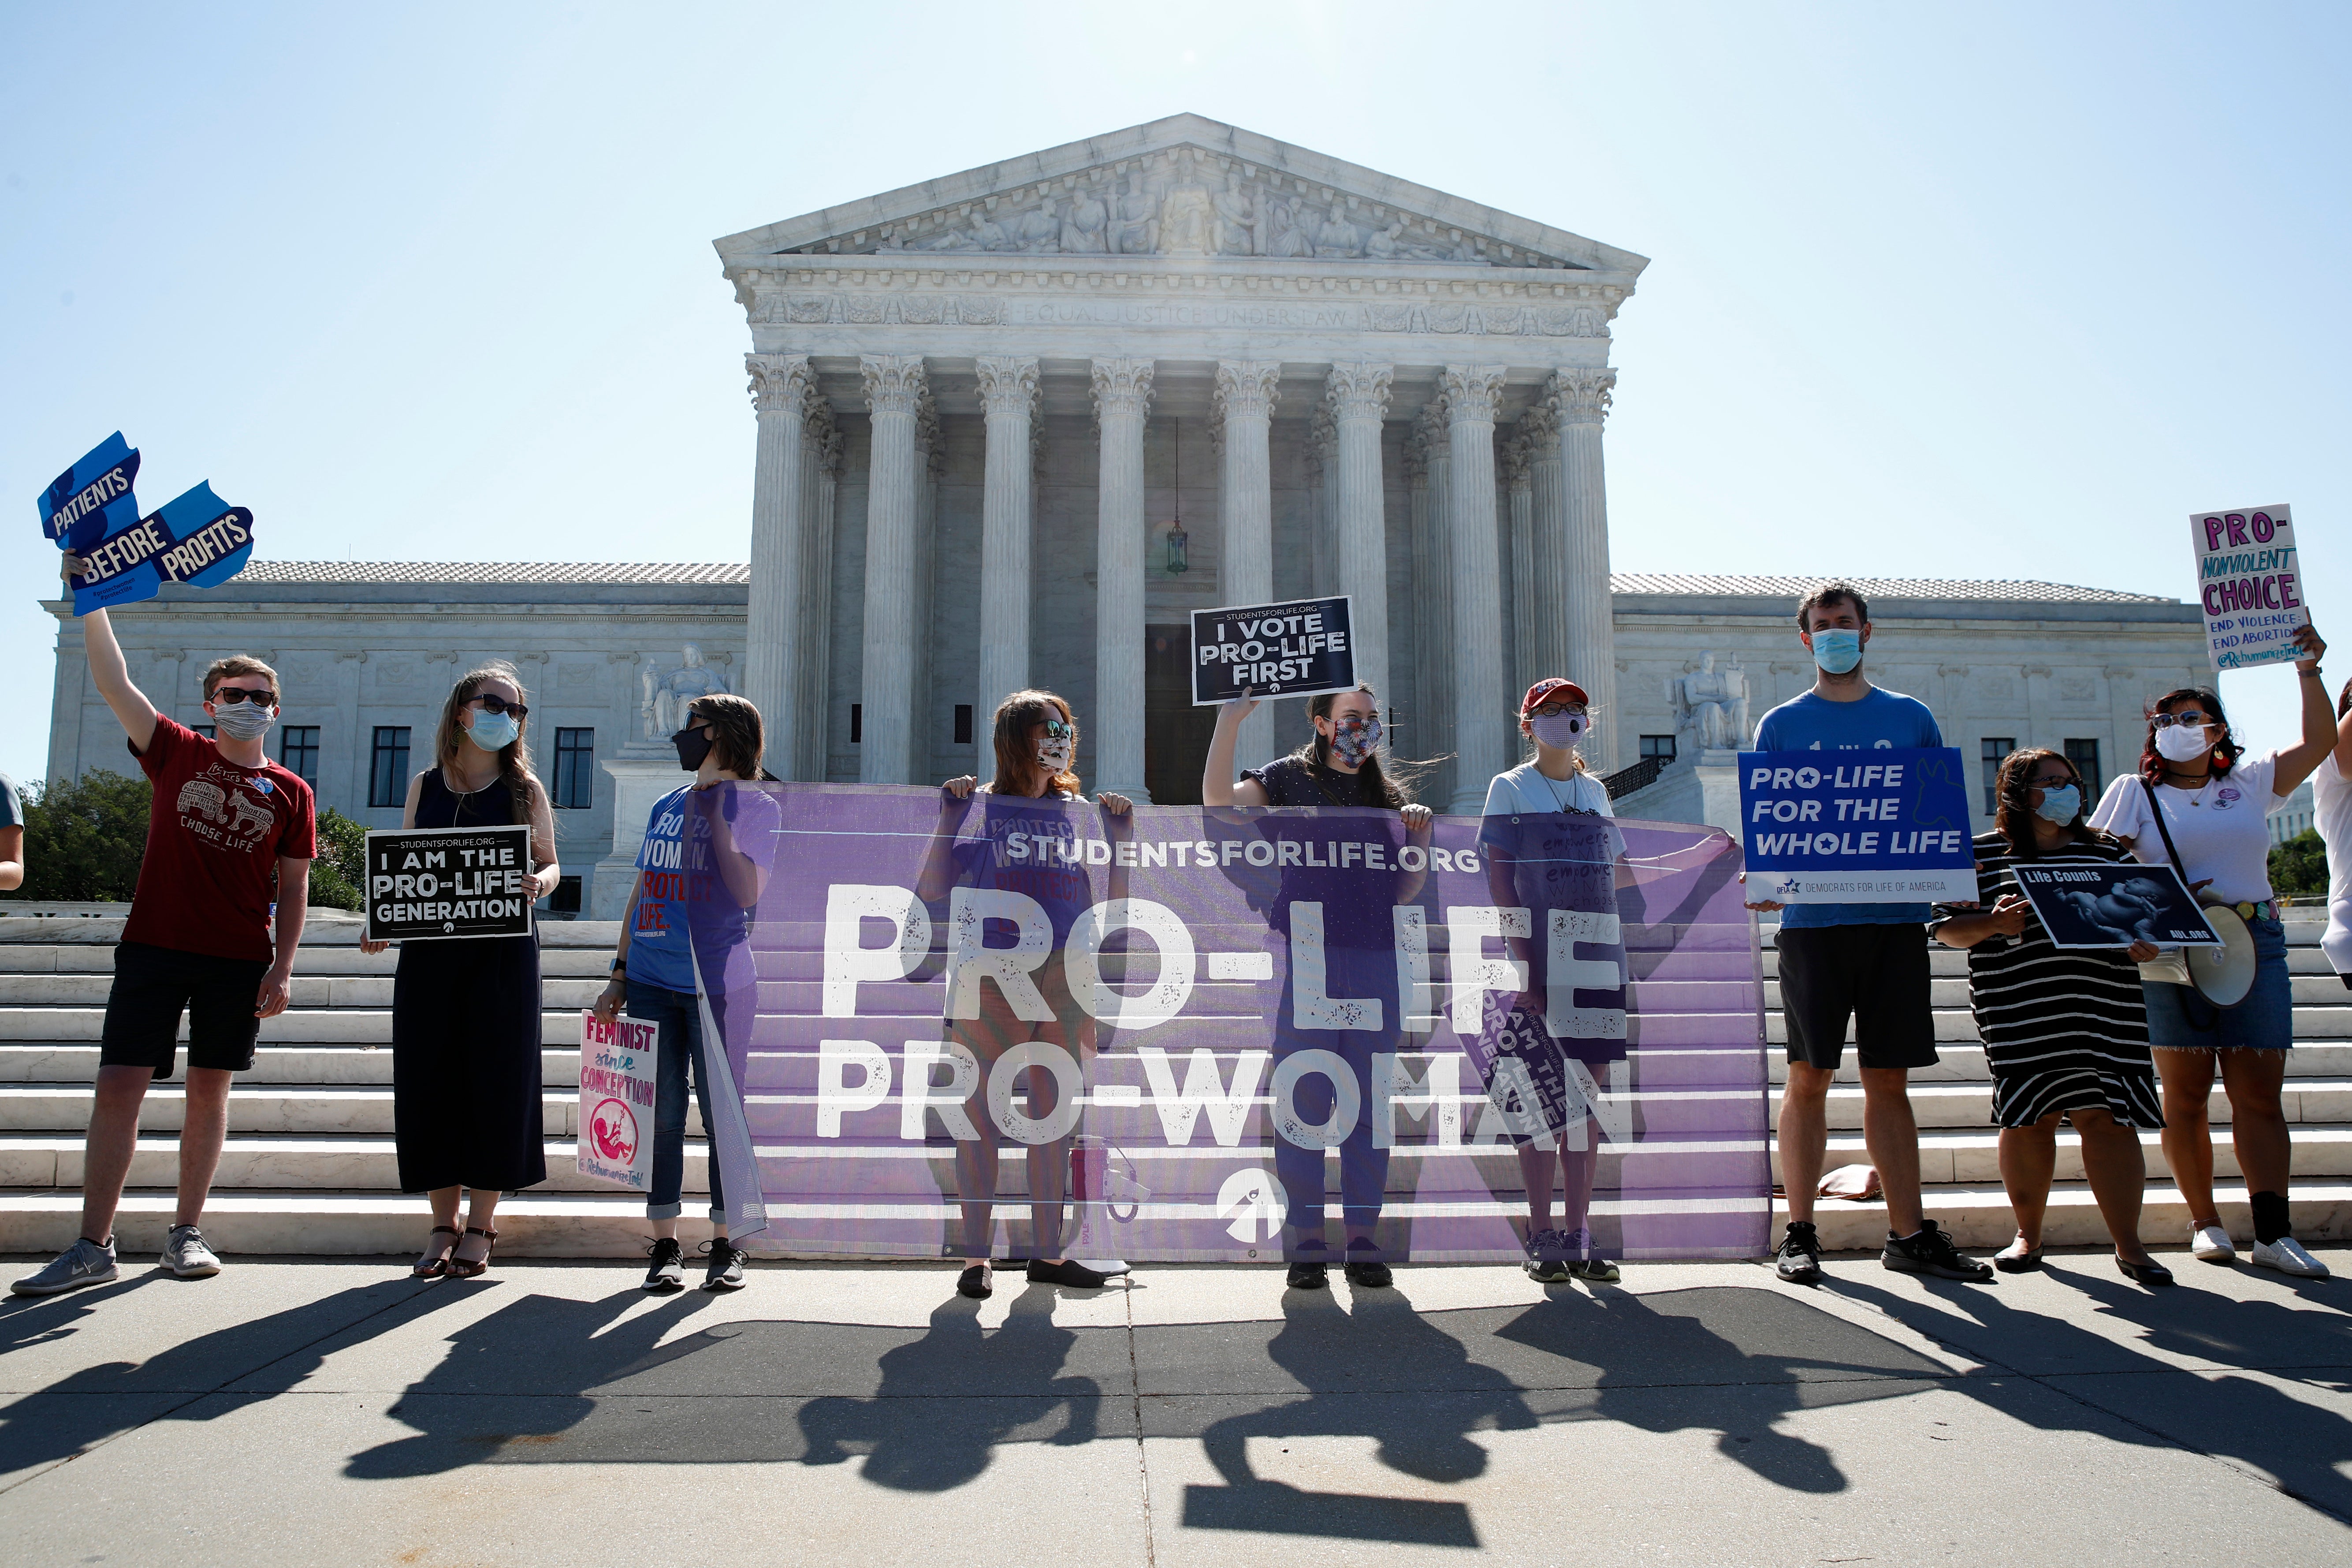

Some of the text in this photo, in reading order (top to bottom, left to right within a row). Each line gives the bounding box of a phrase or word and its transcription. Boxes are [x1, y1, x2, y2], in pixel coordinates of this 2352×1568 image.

[1024, 304, 1347, 326] EQUAL JUSTICE UNDER LAW
[52, 467, 128, 536] PATIENTS
[2203, 511, 2287, 551] PRO-
[82, 514, 247, 584] BEFORE PROFITS
[2201, 547, 2296, 580] NONVIOLENT
[93, 577, 136, 596] #protectwomen
[100, 586, 133, 600] #protectlife
[2203, 574, 2300, 616] CHOICE
[1226, 605, 1317, 621] STUDENTSFORLIFE.ORG
[1217, 613, 1323, 642] I VOTE
[2211, 619, 2234, 633] END
[1199, 631, 1346, 665] PRO-LIFE
[2213, 635, 2240, 650] END
[1233, 657, 1314, 685] FIRST
[1749, 765, 1904, 790] PRO-LIFE
[183, 786, 219, 801] PUNISHMENT
[238, 802, 272, 823] ABORTION
[1752, 798, 1900, 823] FOR THE
[181, 816, 223, 842] CHOOSE
[225, 835, 254, 853] LIFE
[400, 838, 495, 849] STUDENTSFORLIFE.ORG
[1755, 830, 1961, 856] WHOLE LIFE
[381, 848, 515, 870] I AM THE
[1006, 832, 1480, 873] STUDENTSFORLIFE.ORG
[373, 869, 523, 899] PRO-LIFE
[1805, 881, 1946, 893] DEMOCRATS FOR LIFE OF AMERICA
[2025, 870, 2102, 883] Life Counts
[376, 898, 521, 922] GENERATION
[637, 903, 671, 930] LIFE.
[2170, 930, 2211, 939] AUL.ORG
[822, 884, 1626, 1040] PRO-LIFE
[587, 1016, 656, 1052] FEMINIST
[595, 1048, 636, 1071] since
[581, 1066, 655, 1108] CONCEPTION
[816, 1039, 1634, 1152] PRO-WOMAN
